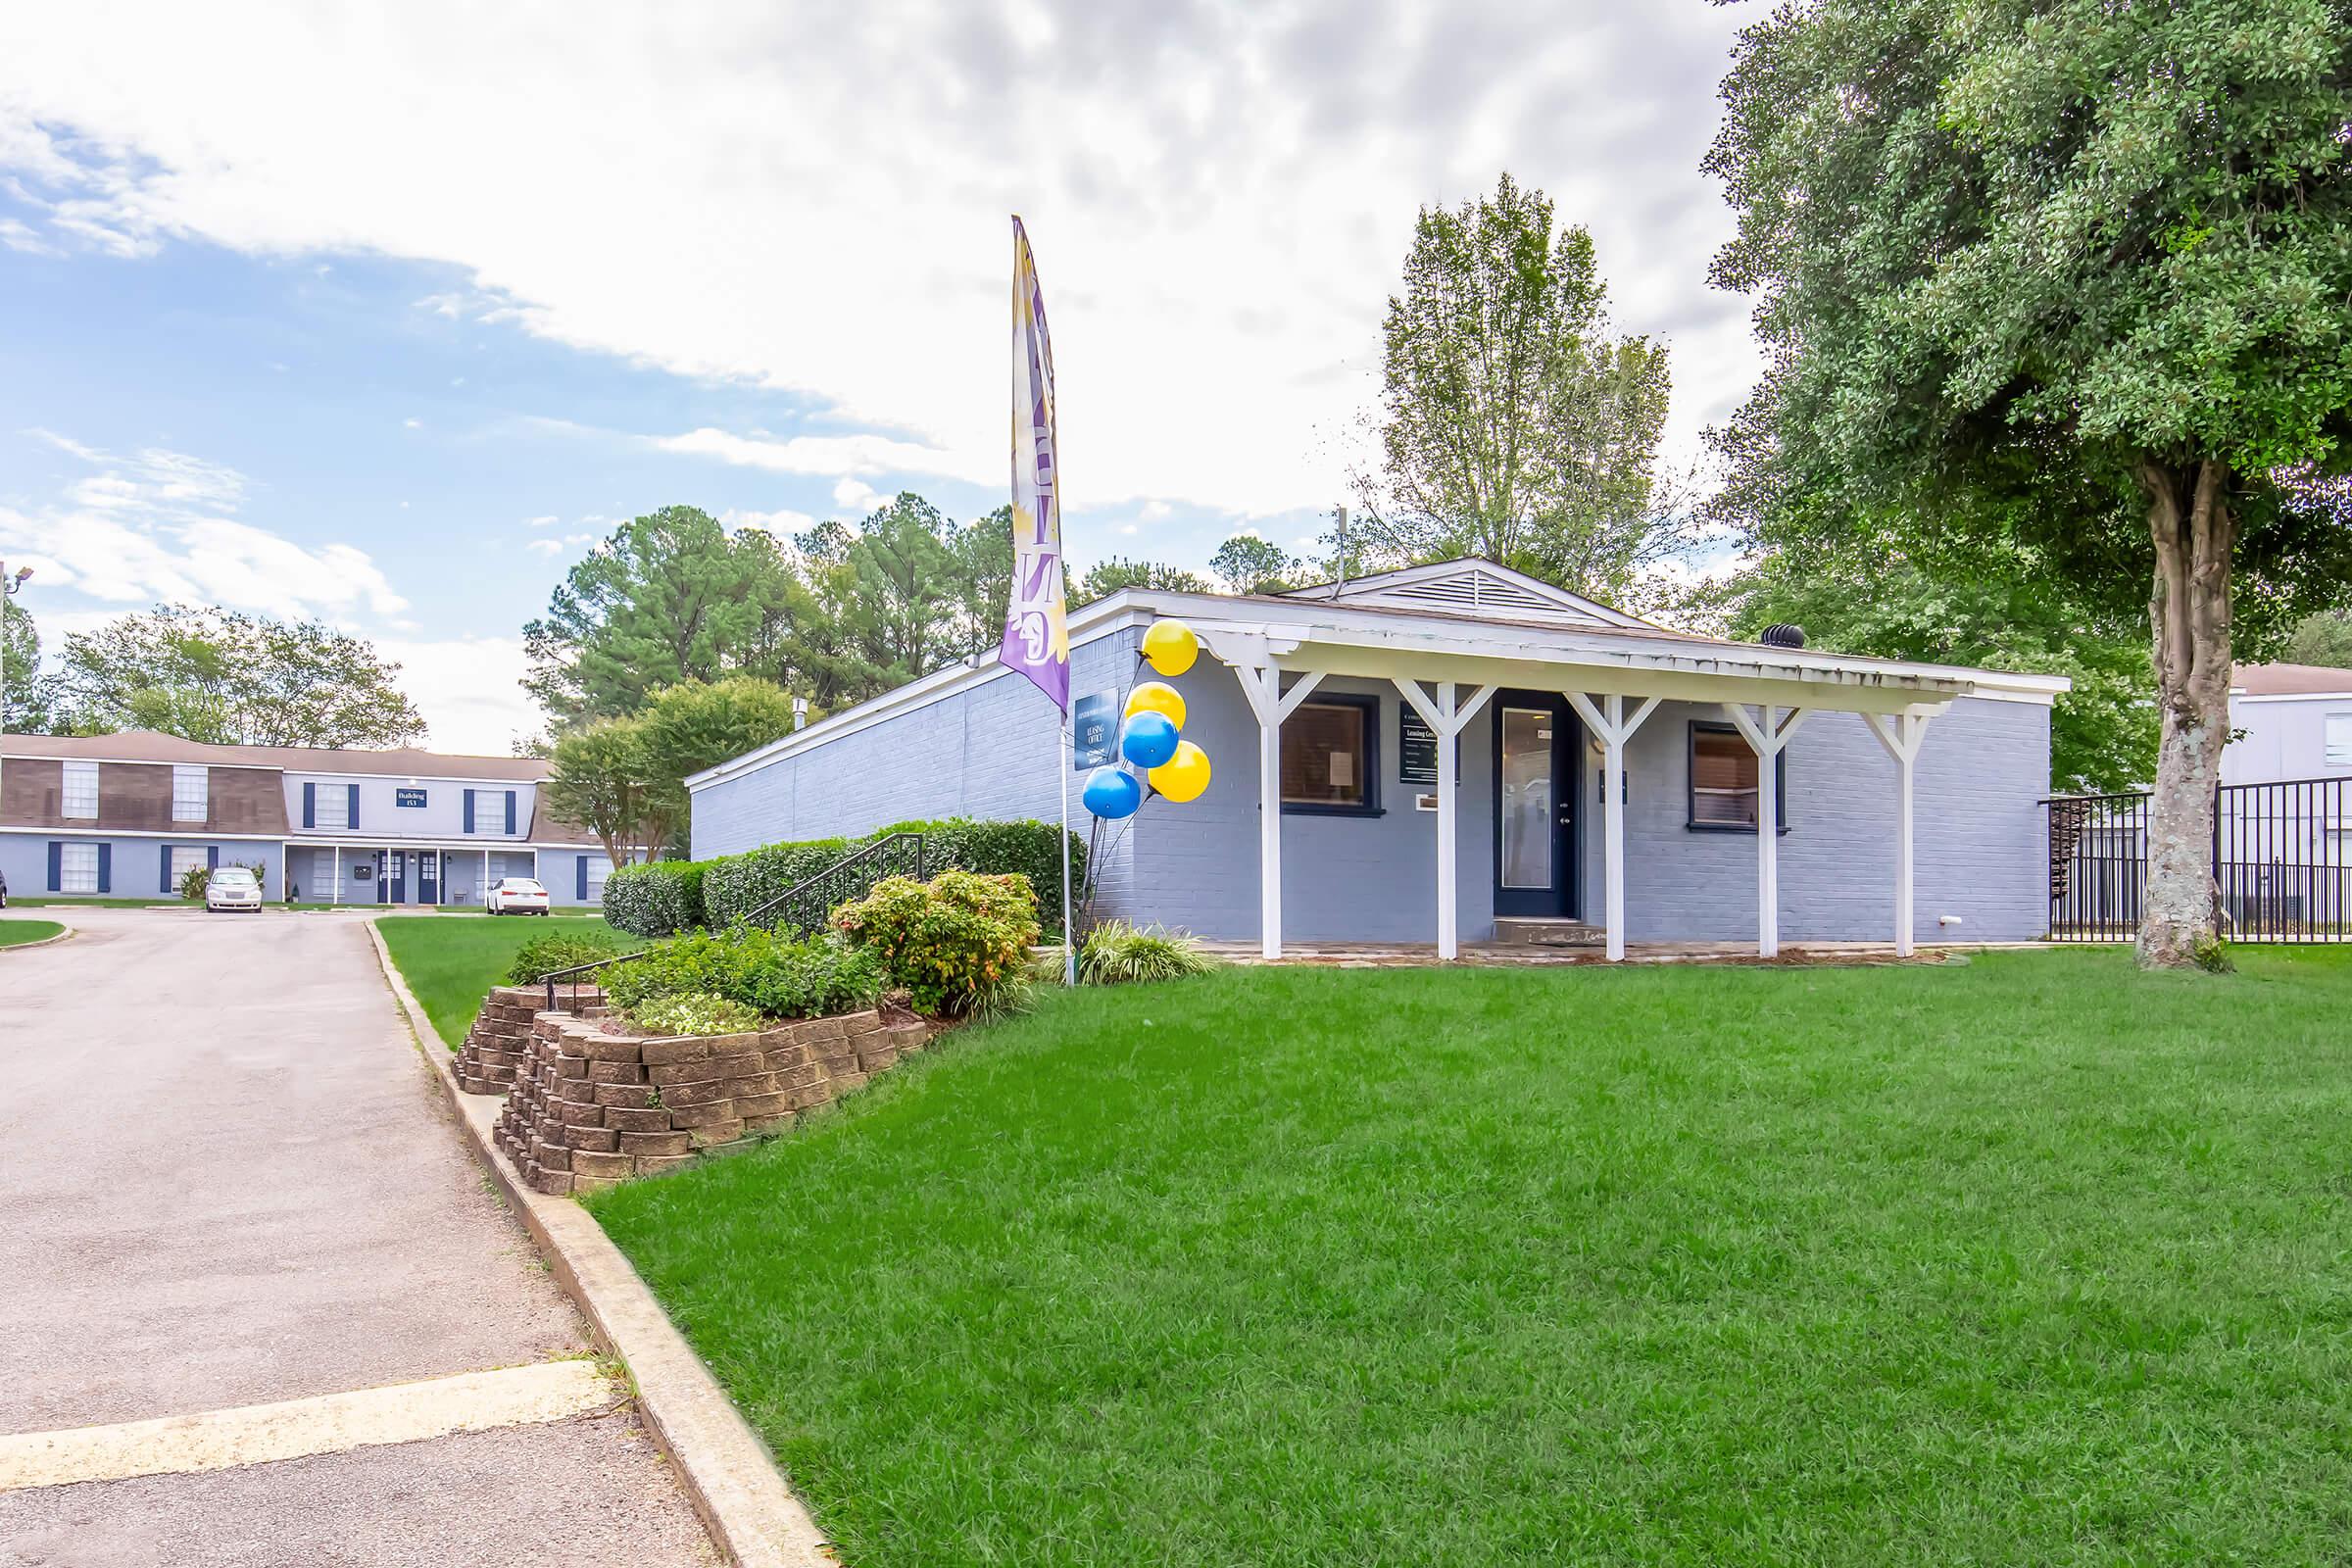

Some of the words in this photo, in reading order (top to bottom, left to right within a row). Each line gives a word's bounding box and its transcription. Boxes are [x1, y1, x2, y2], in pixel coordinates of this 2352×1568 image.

[1088, 724, 1104, 736] LEASING
[1407, 729, 1425, 738] Leasing
[398, 792, 424, 801] Building
